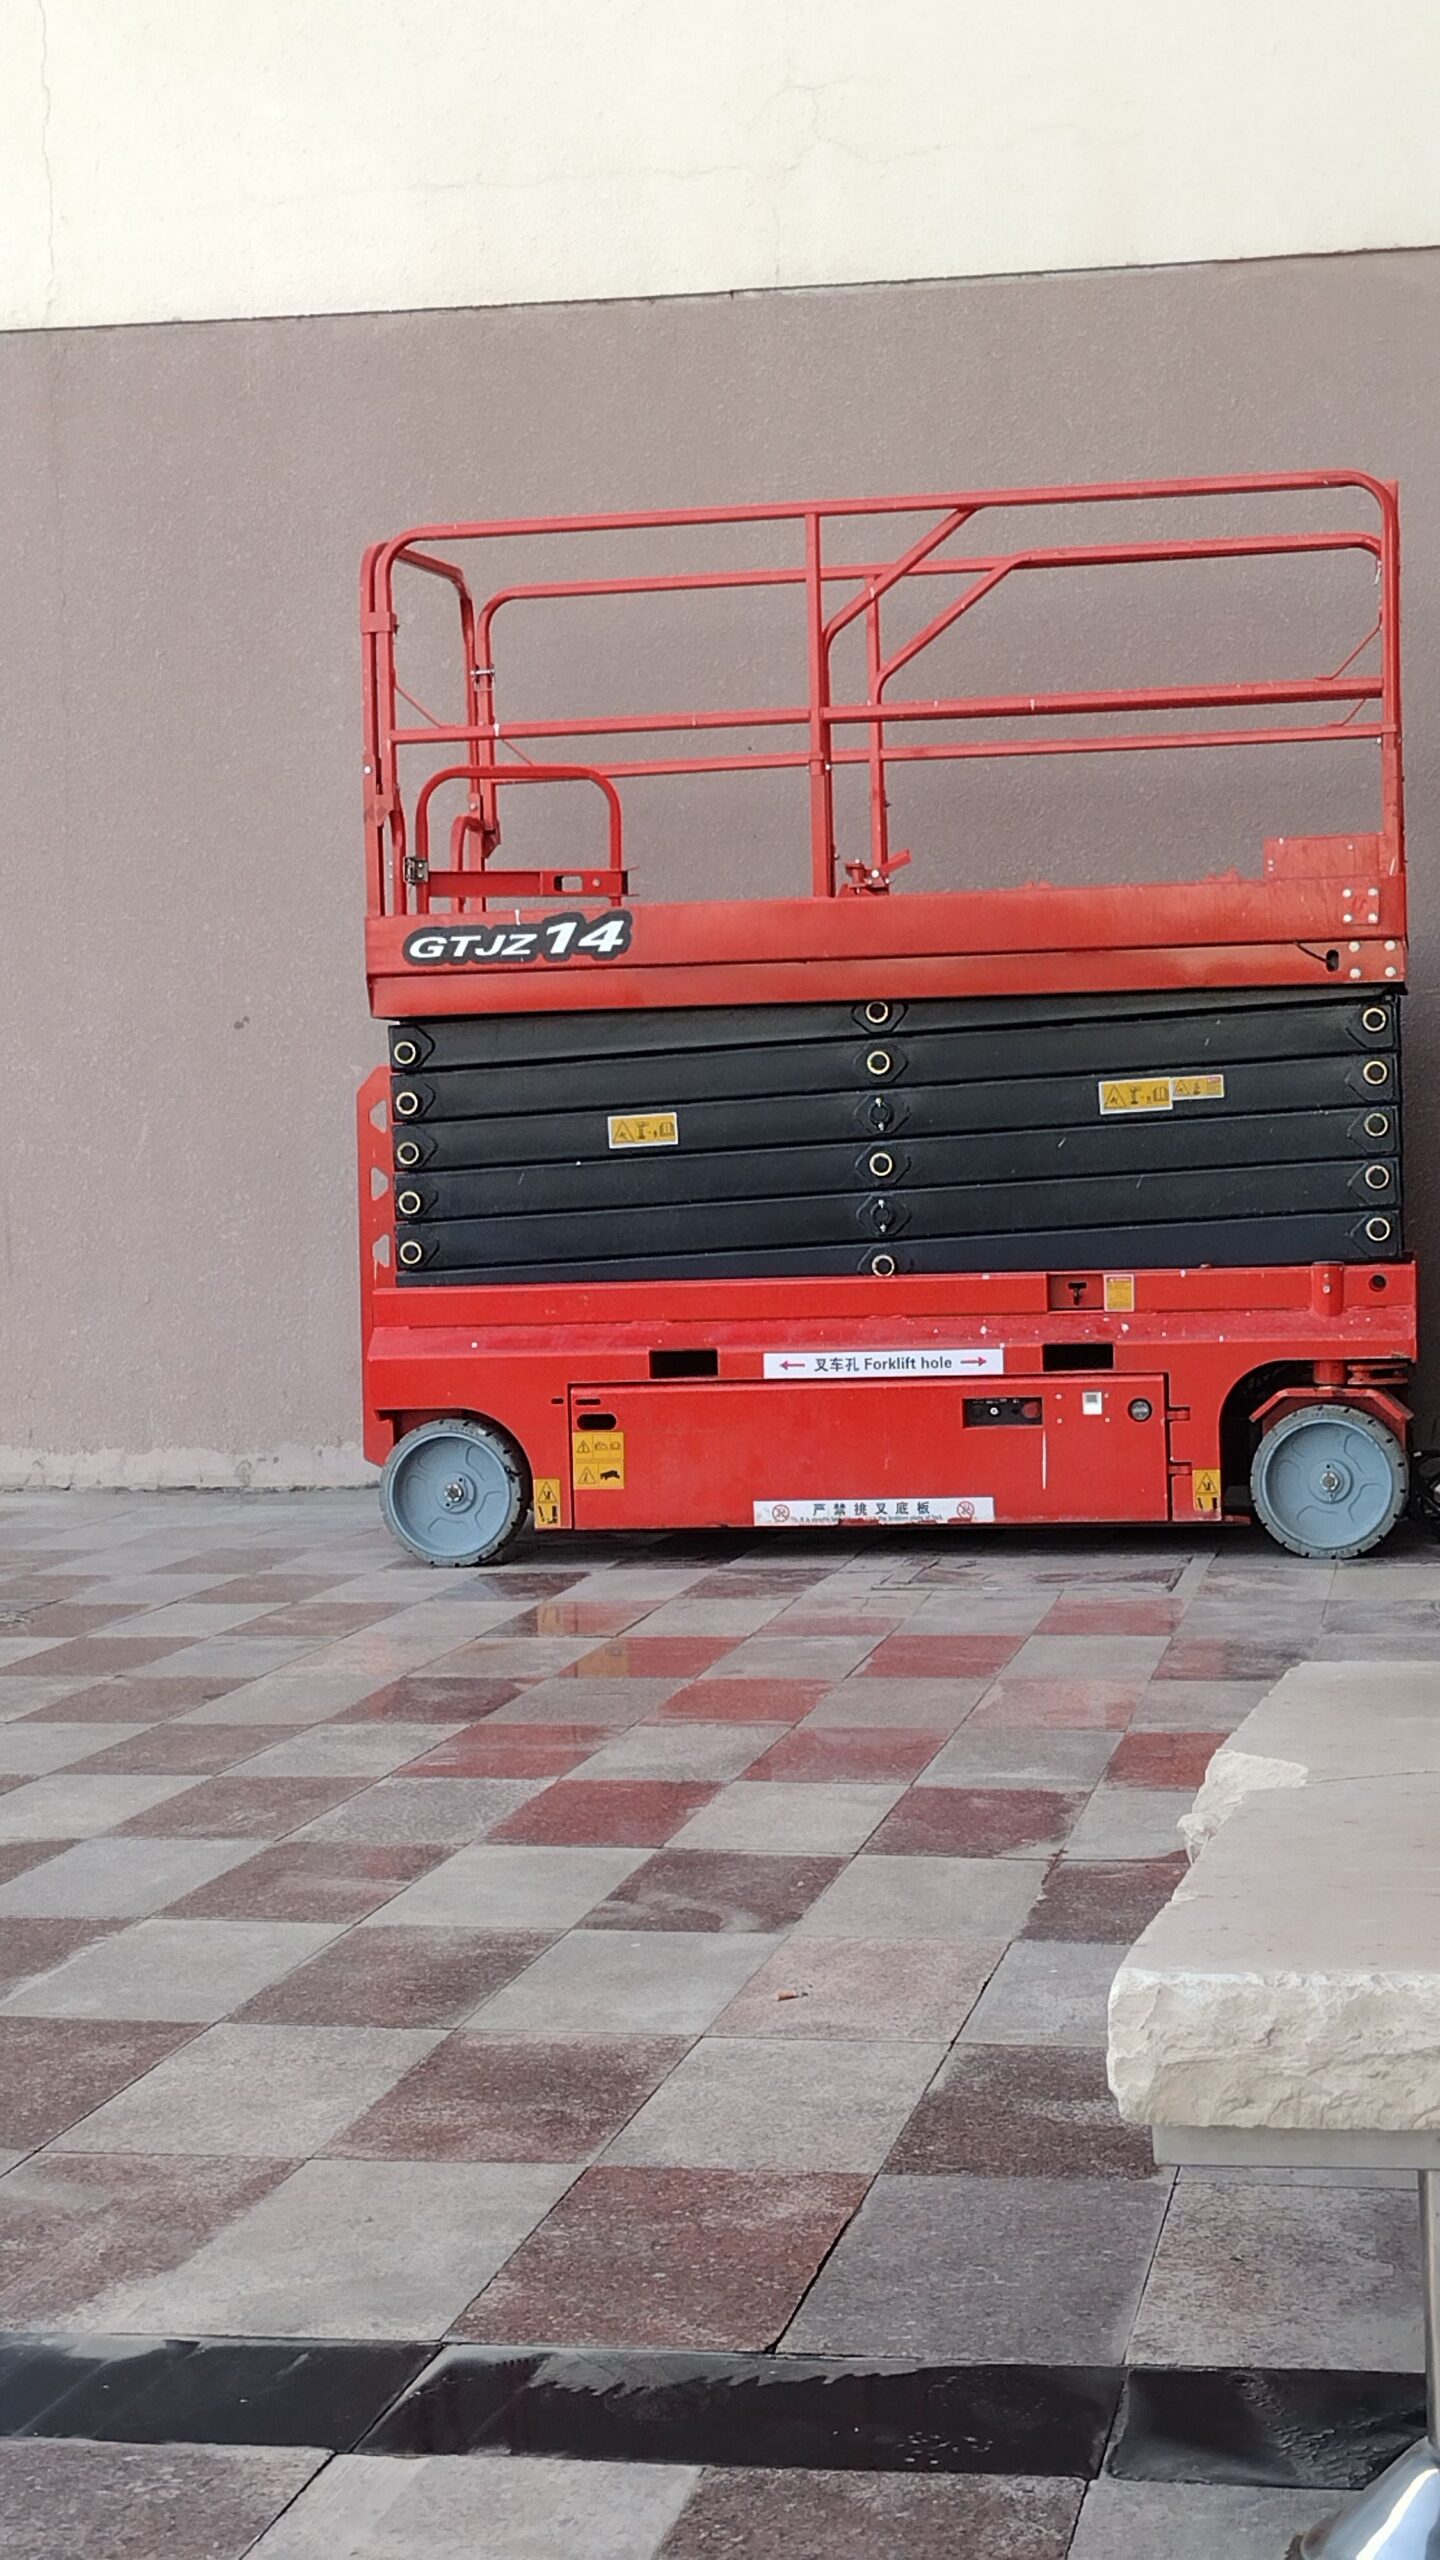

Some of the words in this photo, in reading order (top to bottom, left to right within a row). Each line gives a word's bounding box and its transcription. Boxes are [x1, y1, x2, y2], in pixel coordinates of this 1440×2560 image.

[814, 1356, 859, 1372] 叉车孔
[864, 1356, 916, 1370] Forklift
[921, 1355, 953, 1369] hole
